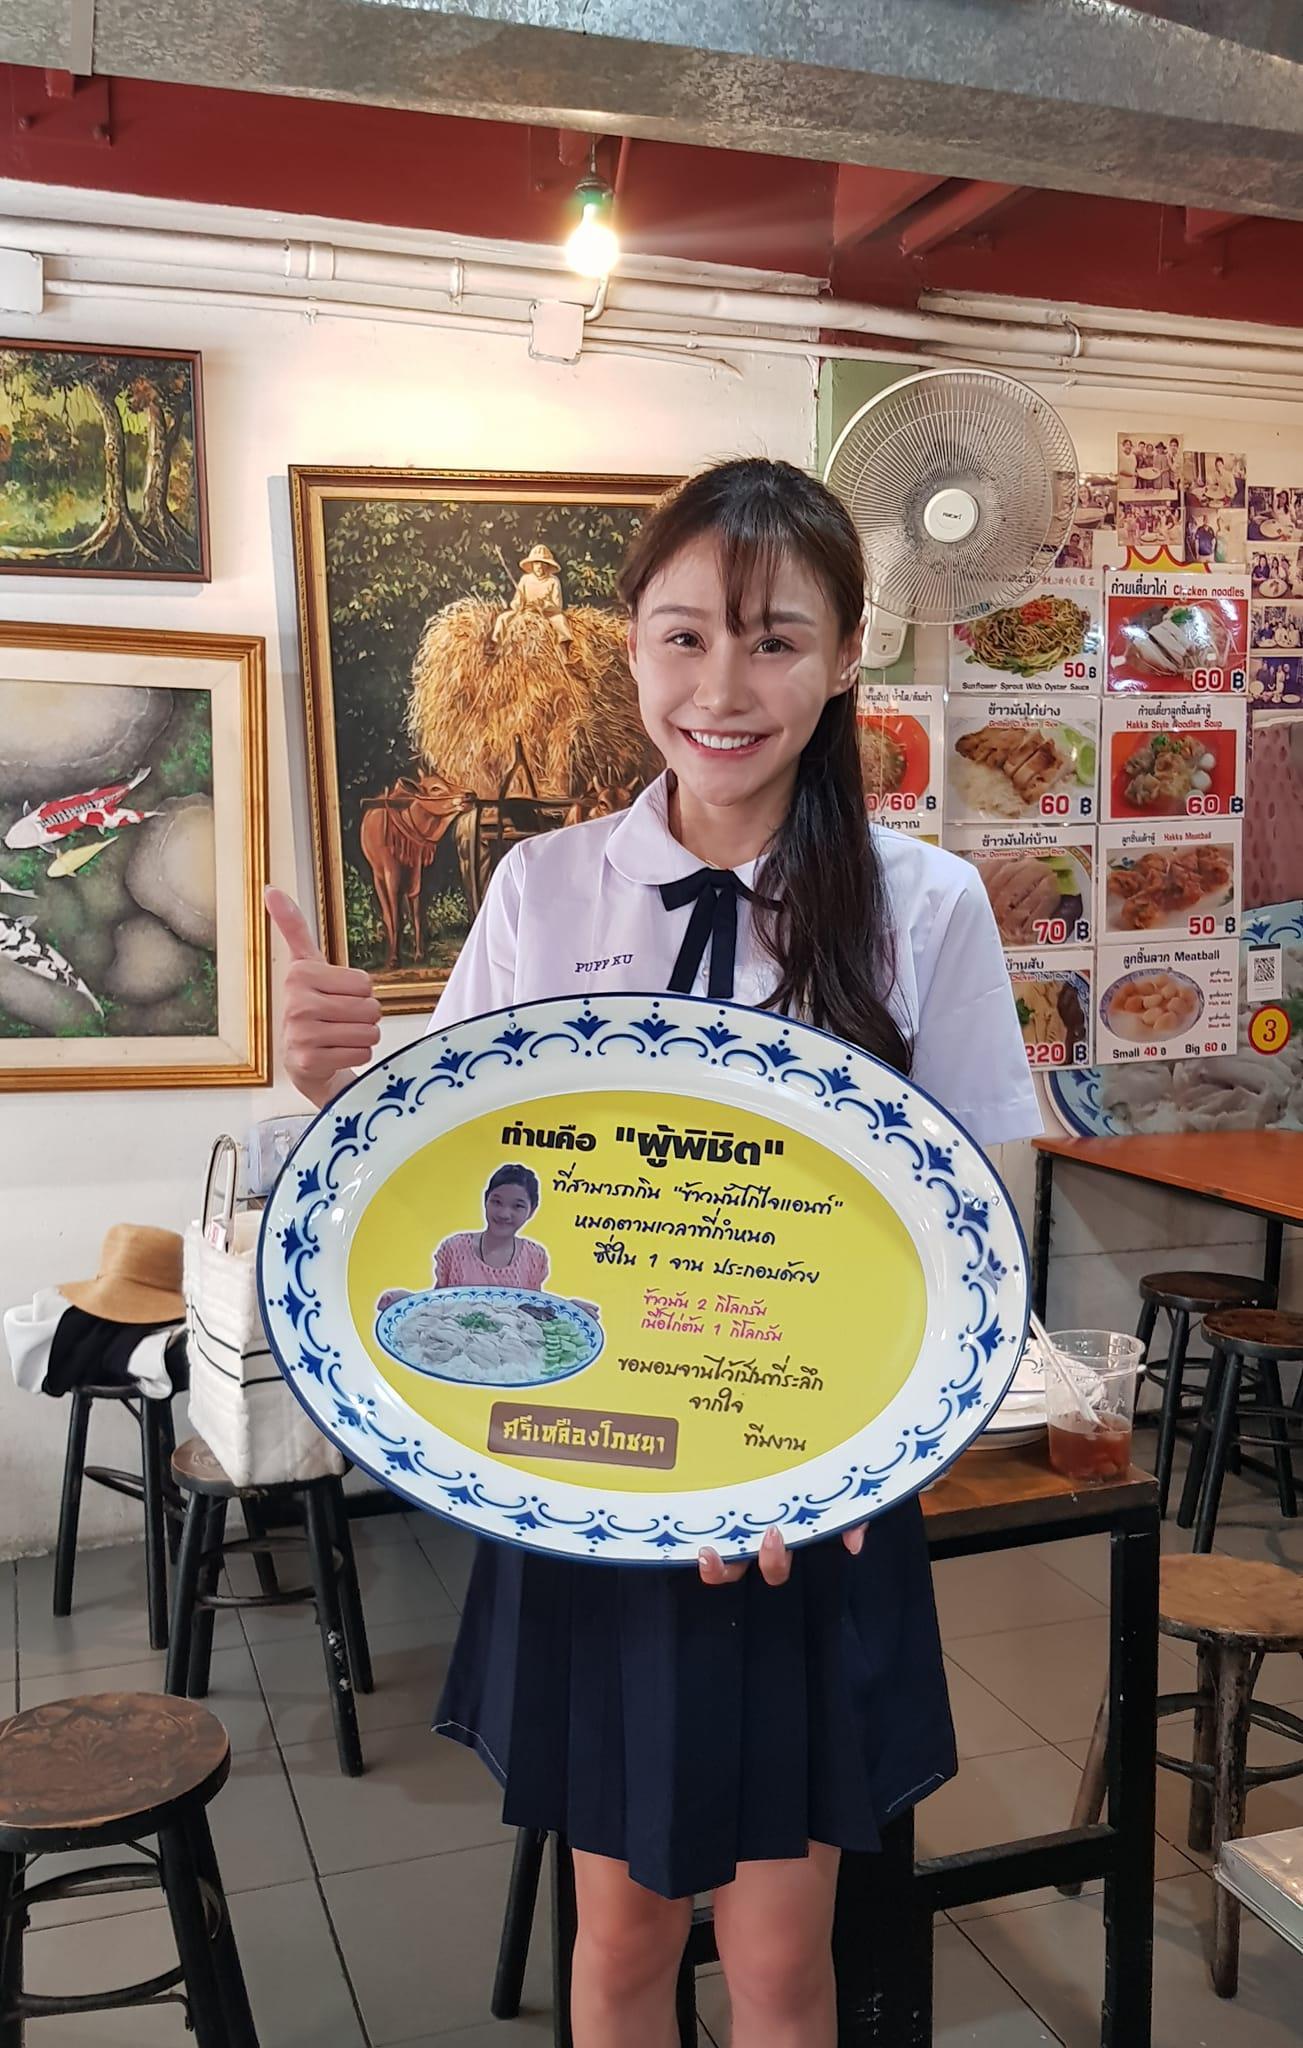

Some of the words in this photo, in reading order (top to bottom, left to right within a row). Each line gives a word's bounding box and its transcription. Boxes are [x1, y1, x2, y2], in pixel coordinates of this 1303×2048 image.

[1211, 586, 1245, 597] noodles
[1064, 662, 1085, 678] 50
[1193, 669, 1222, 690] 60
[1000, 682, 1023, 691] Sprout
[1026, 682, 1043, 690] With
[1044, 682, 1068, 692] Oyster
[1070, 683, 1089, 691] Sauce
[1041, 795, 1070, 815] 60
[1187, 796, 1219, 815] 60
[1034, 920, 1066, 942] 70
[1188, 916, 1215, 935] 50
[1174, 950, 1220, 962] Meatball
[1263, 1018, 1277, 1043] 3
[1112, 1048, 1140, 1059] Small
[1144, 1046, 1158, 1056] 40
[1185, 1044, 1200, 1055] Big
[1204, 1042, 1217, 1052] 60
[501, 1121, 596, 1151] ท่านคือ
[615, 1124, 785, 1168] "ผู้พิชิต"
[552, 1163, 661, 1200] ที่สามารถกิน
[574, 1208, 776, 1245] หมดตามเวลาที่กำหนด
[593, 1234, 636, 1266] ซึ่งใน
[649, 1253, 658, 1267] 1
[669, 1256, 703, 1272] จาน
[713, 1258, 820, 1284] ประกอบด้วย
[643, 1288, 689, 1310] ข้าวมัน
[697, 1298, 707, 1311] 2
[714, 1294, 768, 1317] กิโลกรัม
[641, 1308, 704, 1334] เนื้อไก่ต้ม
[713, 1323, 721, 1336] 1
[729, 1319, 783, 1342] กิโลกรัม
[618, 1355, 824, 1391] ขอมอบจานไว้เป็นที่ระลึก
[689, 1387, 744, 1414] จากใจ
[502, 1414, 665, 1455] ศรีเหลืองโภชนา
[744, 1423, 806, 1452] ทีมงาน
